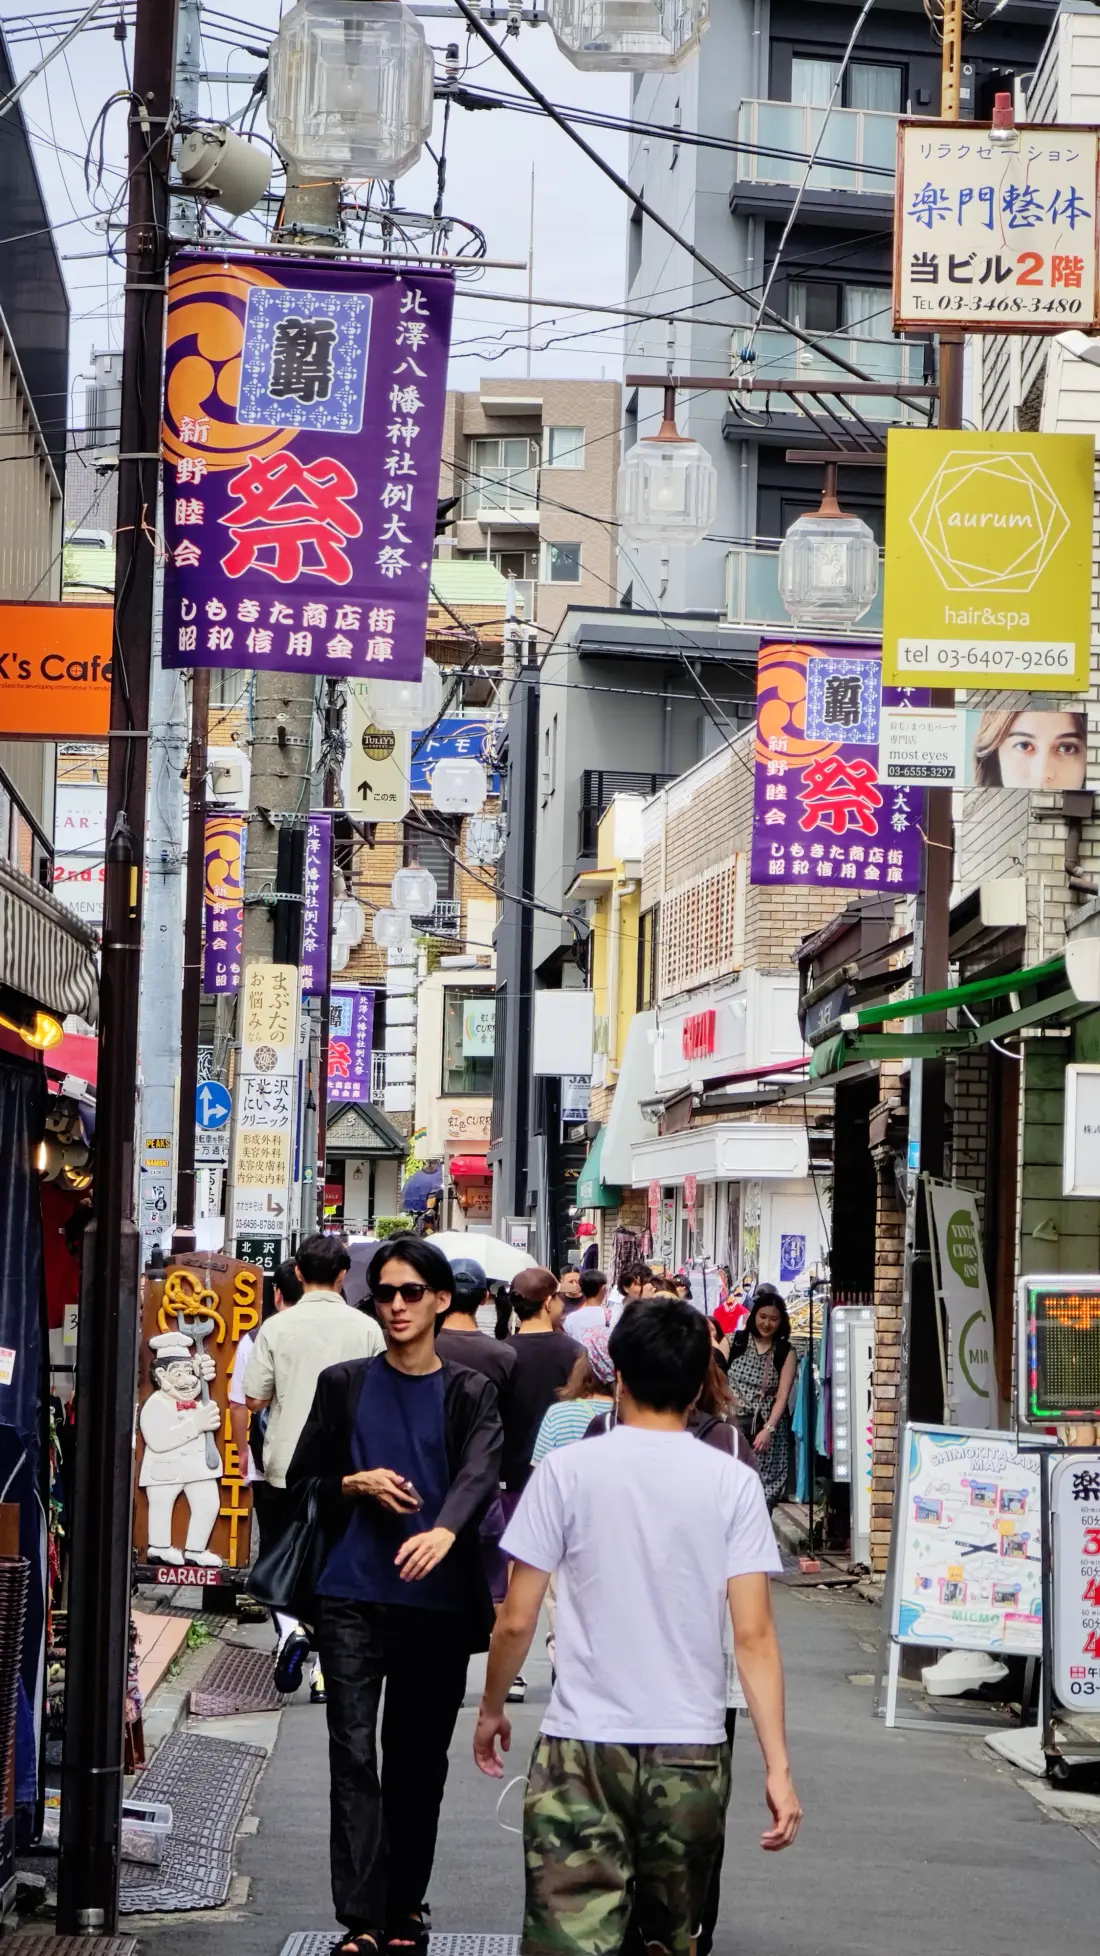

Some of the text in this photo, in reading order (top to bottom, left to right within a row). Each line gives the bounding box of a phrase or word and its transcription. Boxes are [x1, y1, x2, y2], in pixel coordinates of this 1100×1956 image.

[921, 143, 1080, 163] リラクゼーション
[907, 181, 1092, 230] 楽門整体
[910, 252, 1085, 289] 当ビル2階
[938, 295, 1082, 314] 03-3468-3480
[375, 289, 431, 579] 北澤八幡神社例大祭
[173, 415, 210, 568] 新野睦会
[218, 450, 364, 586] 祭
[948, 511, 1033, 529] aurum
[180, 597, 396, 634] しもきた商店街
[944, 605, 1030, 631] hair&spa
[178, 625, 396, 662] 昭和信用金庫
[905, 645, 1069, 670] tel 03-6407-9266
[889, 750, 949, 764] most eyes
[764, 735, 788, 826] 新野睦会
[888, 766, 954, 778] 03-6555-3297
[373, 793, 398, 802] この先
[797, 754, 884, 837] 祭
[770, 842, 903, 866] しもきた商店街
[53, 866, 92, 882] 2nd
[768, 859, 904, 883] 昭和信用金庫
[268, 971, 291, 1043] まぶたの
[244, 1078, 290, 1096] 下北沢
[243, 1096, 289, 1114] にいみ
[240, 1114, 289, 1128] クリニック
[145, 1139, 171, 1149] PEAKS
[243, 1134, 282, 1146] 形成外科
[242, 1146, 282, 1159] 美容外科
[237, 1160, 286, 1172] 美容皮膚科
[241, 1241, 275, 1255] 北沢
[219, 1271, 259, 1568] SPETTI
[971, 1459, 1007, 1473] MAP
[157, 1567, 218, 1586] GARAGE
